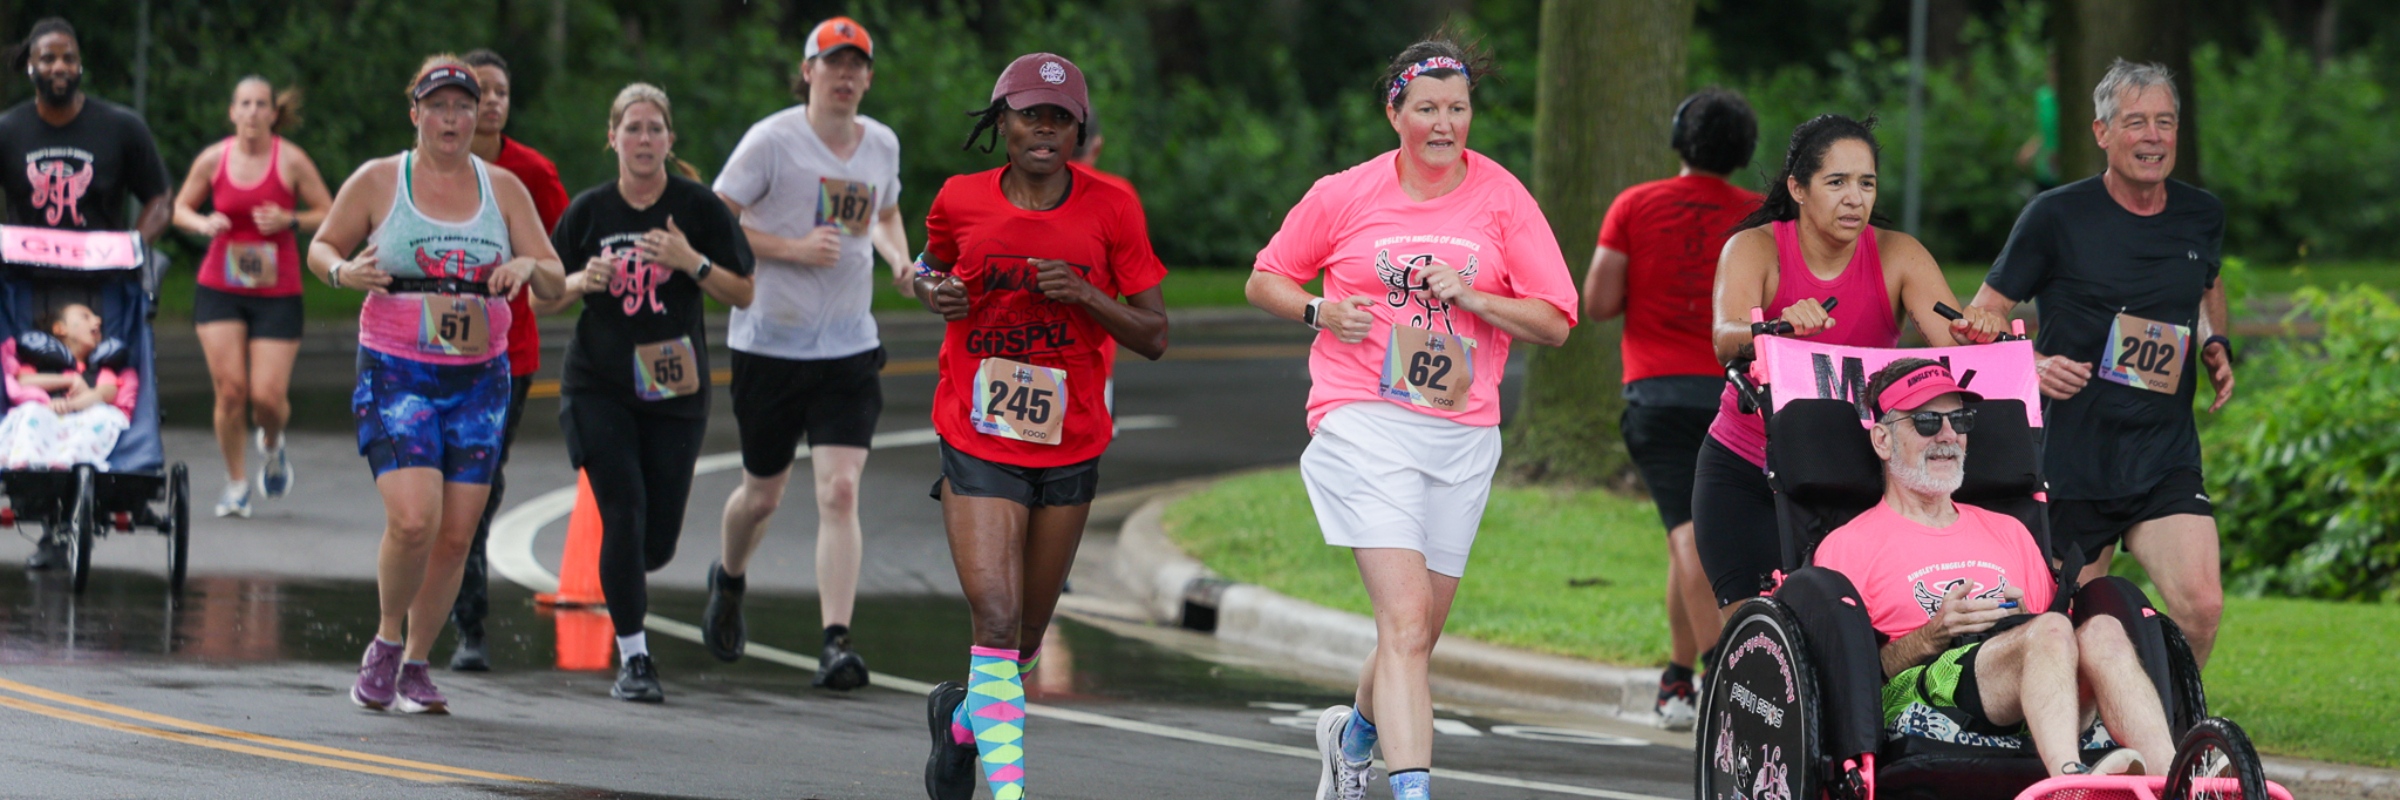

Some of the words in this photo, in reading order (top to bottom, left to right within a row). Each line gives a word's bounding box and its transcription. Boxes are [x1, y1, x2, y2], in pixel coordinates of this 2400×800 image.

[830, 194, 868, 222] 187
[21, 236, 114, 261] Gray
[1374, 235, 1411, 249] AINSLEY'S
[1411, 234, 1439, 245] ANGELS
[1439, 235, 1450, 244] OF
[1450, 237, 1480, 252] AMERICA
[440, 313, 471, 342] 51
[966, 322, 1076, 354] GOSPEL
[2117, 335, 2175, 377] 202
[654, 356, 683, 385] 55
[1408, 350, 1452, 391] 62
[986, 380, 1053, 424] 245
[1433, 397, 1454, 407] FOOD
[1022, 428, 1047, 439] FOOD
[1907, 563, 1940, 583] AINSLEY'S
[1941, 560, 1966, 571] ANGELS
[1977, 560, 2006, 575] AMERICA
